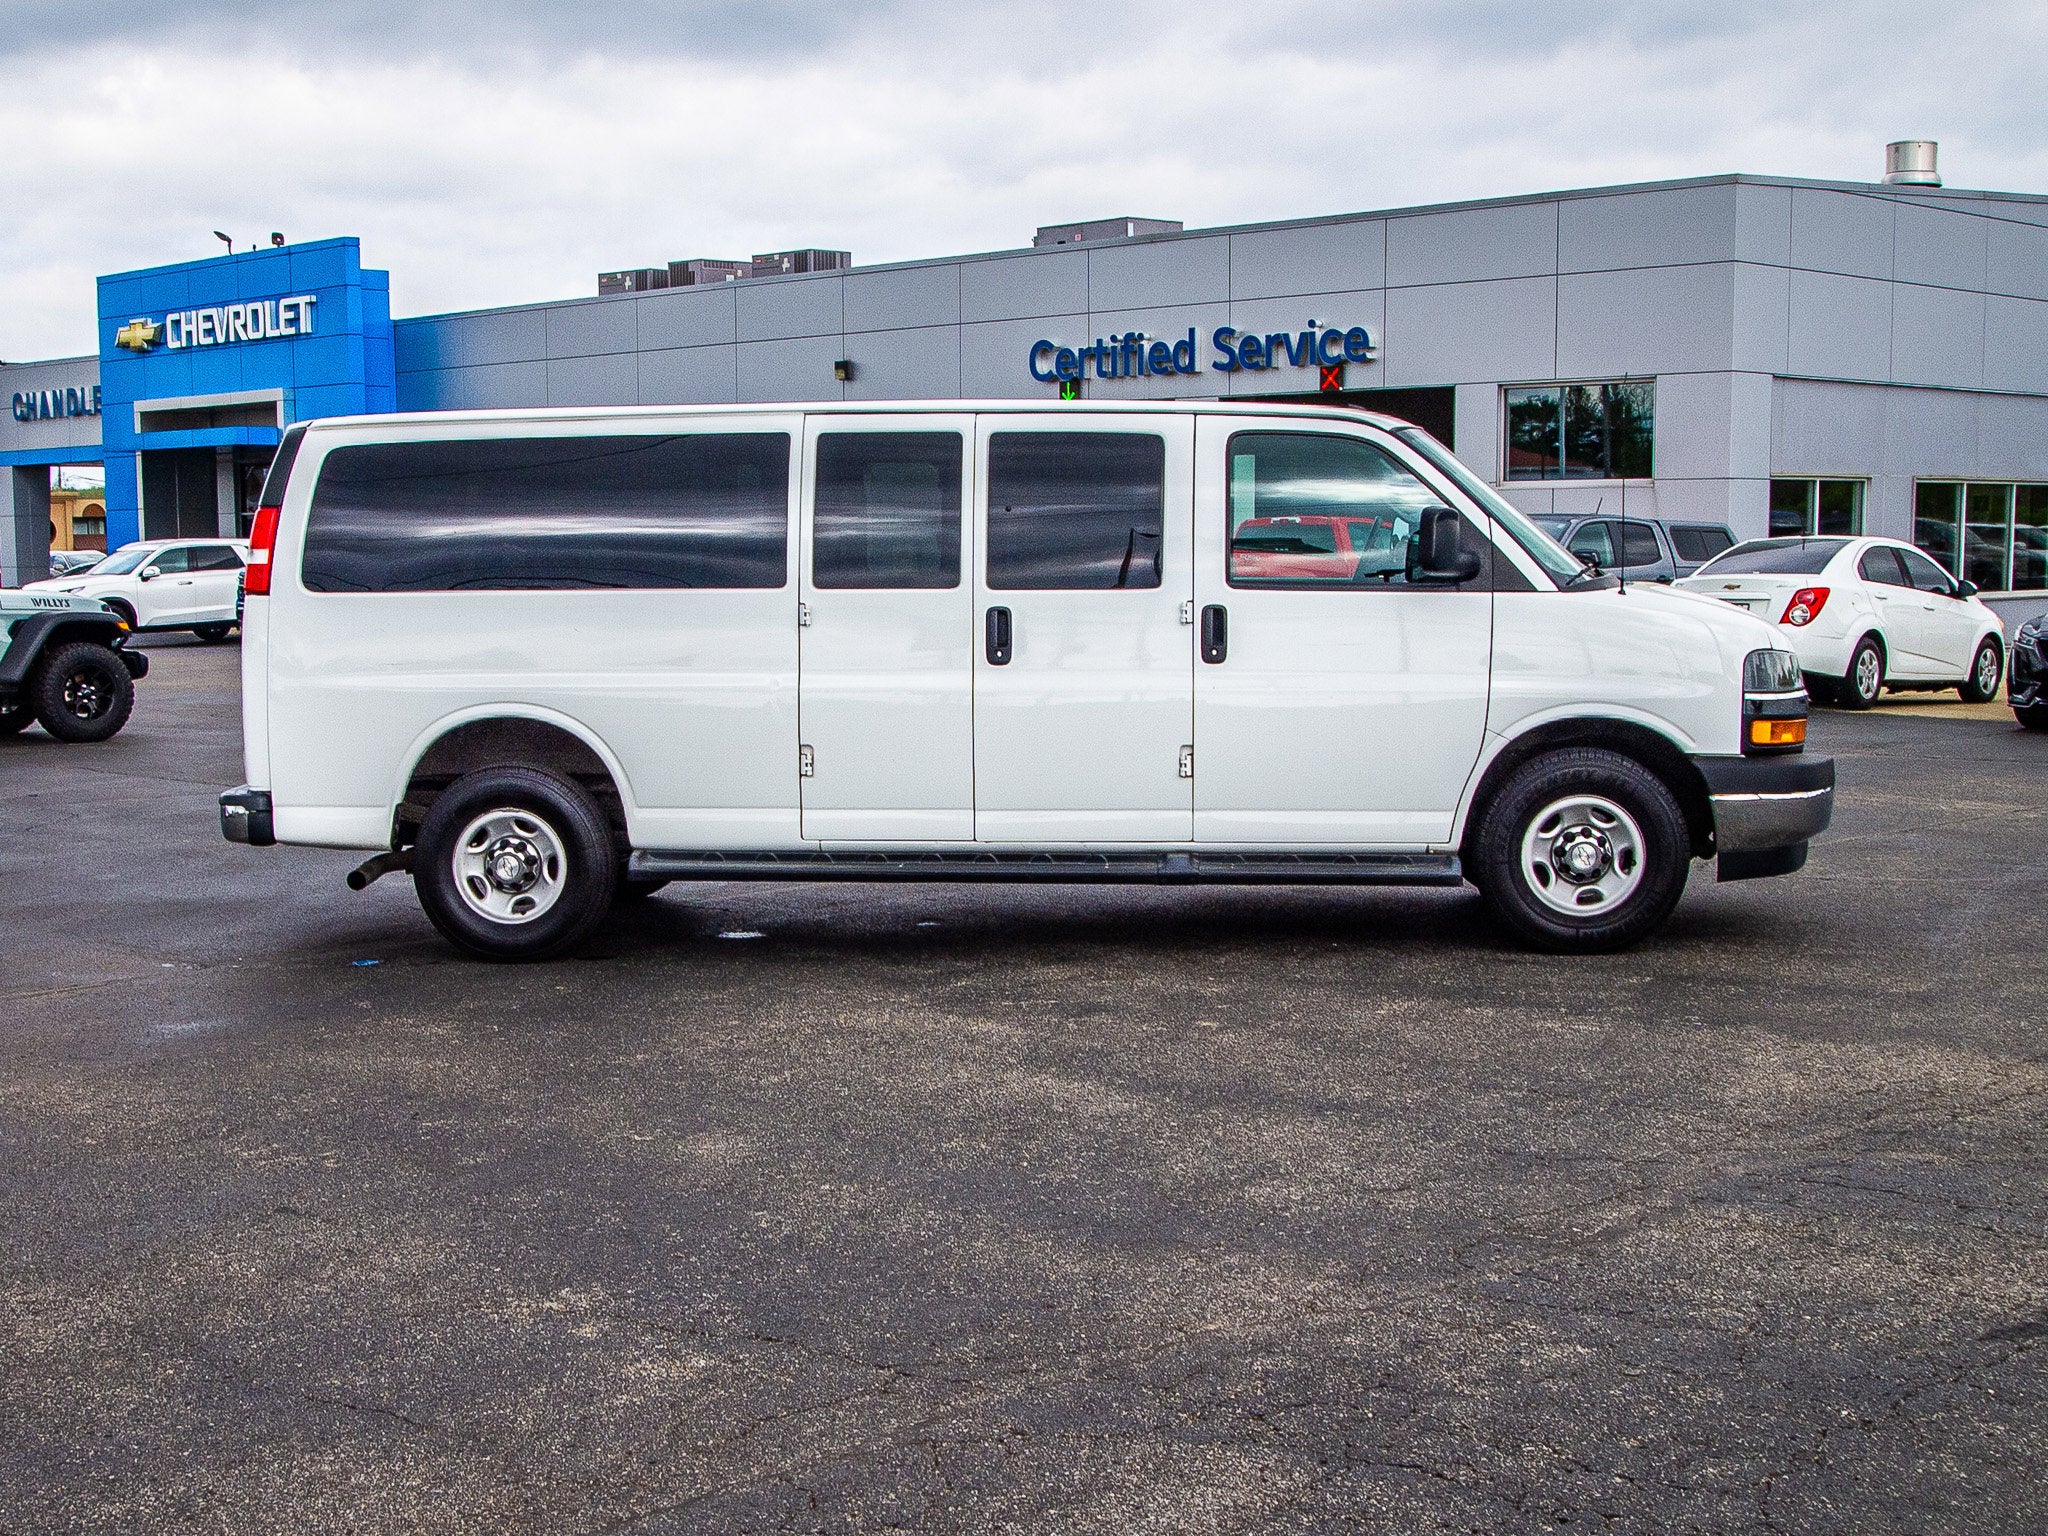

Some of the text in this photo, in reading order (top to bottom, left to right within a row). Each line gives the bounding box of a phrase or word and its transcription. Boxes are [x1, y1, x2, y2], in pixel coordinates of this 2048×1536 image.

[165, 294, 317, 349] CHEVROLET
[1029, 318, 1374, 383] Certified Service
[30, 597, 71, 608] WILLYS
